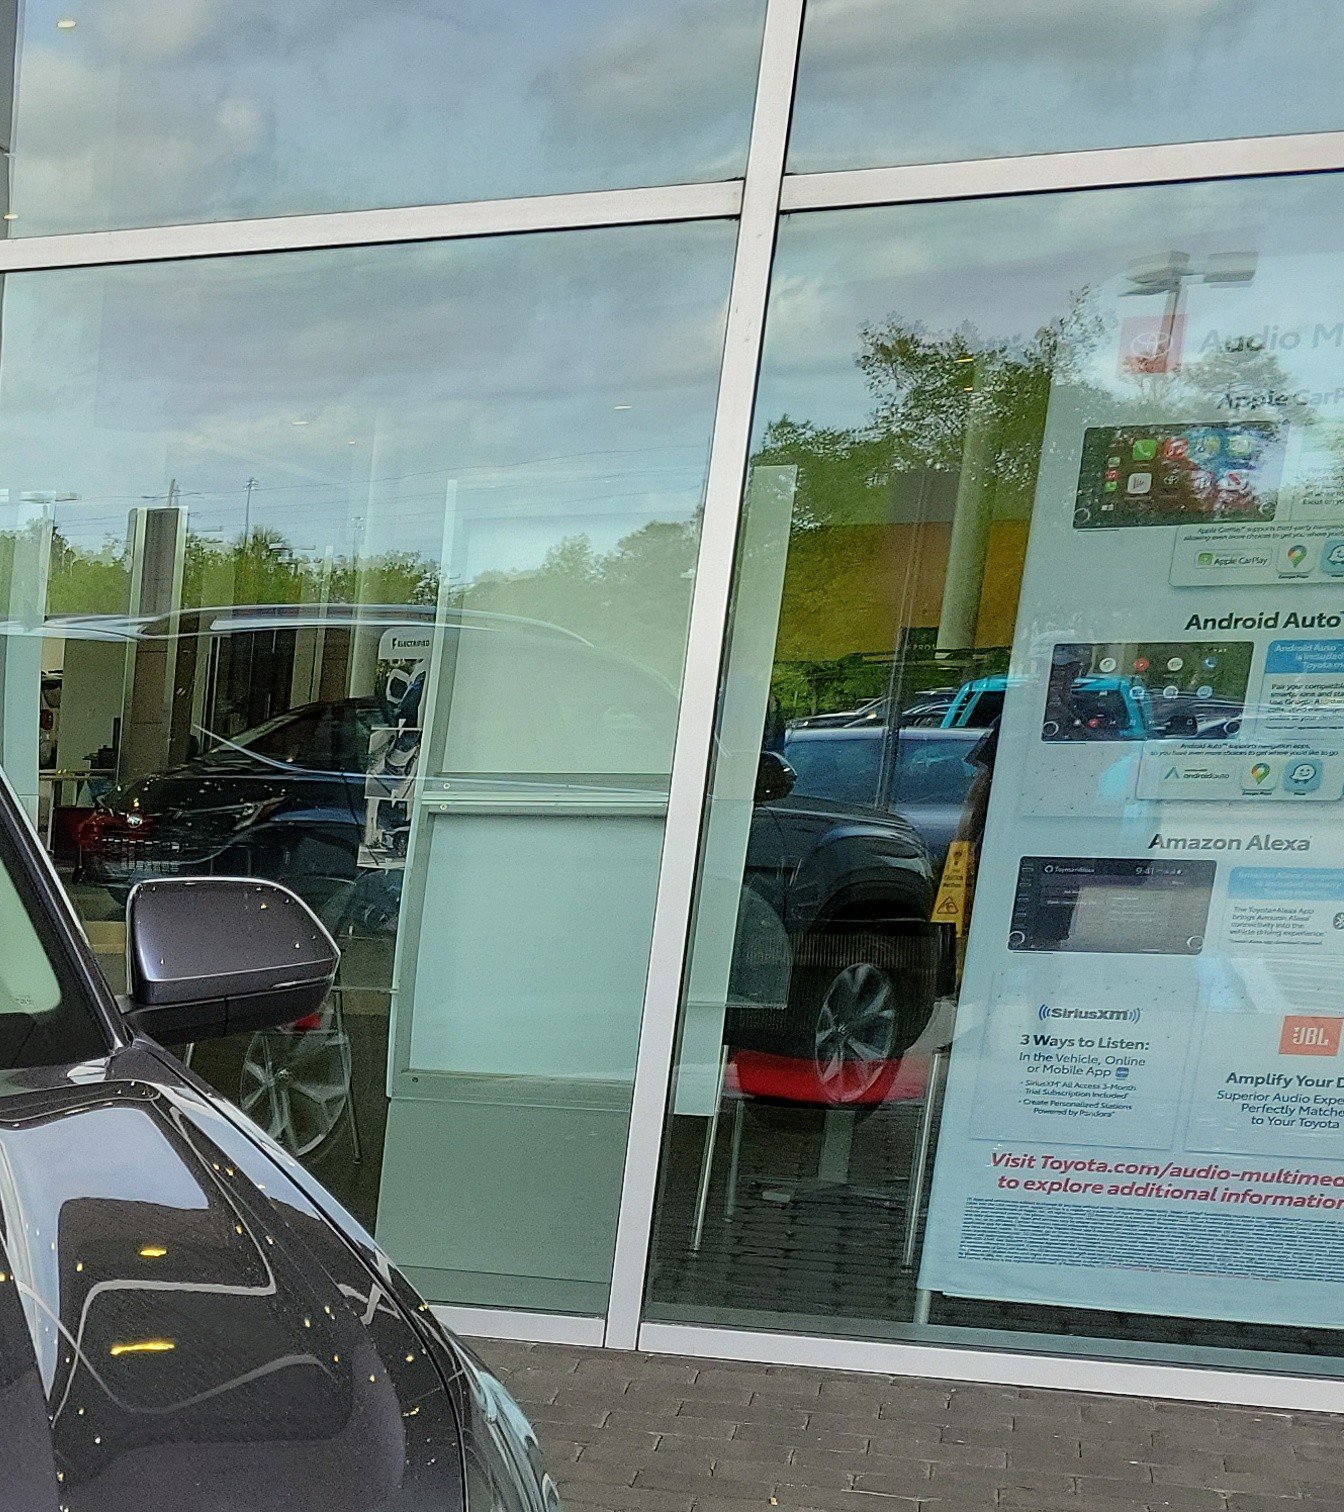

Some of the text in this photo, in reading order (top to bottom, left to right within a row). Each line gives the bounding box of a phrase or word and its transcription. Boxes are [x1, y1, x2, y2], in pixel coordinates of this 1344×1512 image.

[1198, 325, 1301, 352] Audio
[1184, 612, 1280, 631] Android
[1148, 833, 1242, 850] Amazon
[1020, 1034, 1150, 1051] 3 Ways to Listen:
[1292, 1027, 1329, 1046] JBL
[1019, 1052, 1146, 1067] In the Vehicle, Online
[1027, 1065, 1040, 1073] or
[1042, 1064, 1083, 1075] Mobile
[1085, 1067, 1112, 1079] App
[1225, 1072, 1293, 1089] Amplify
[1296, 1075, 1335, 1088] Your
[1217, 1090, 1271, 1102] Superior
[1272, 1093, 1311, 1104] Audio
[1241, 1103, 1296, 1117] Perfectly
[1251, 1116, 1340, 1130] to Your Toyota
[991, 1152, 1036, 1169] Visit
[997, 1175, 1019, 1190] to
[1023, 1177, 1104, 1196] explore
[1106, 1181, 1218, 1203] additional
